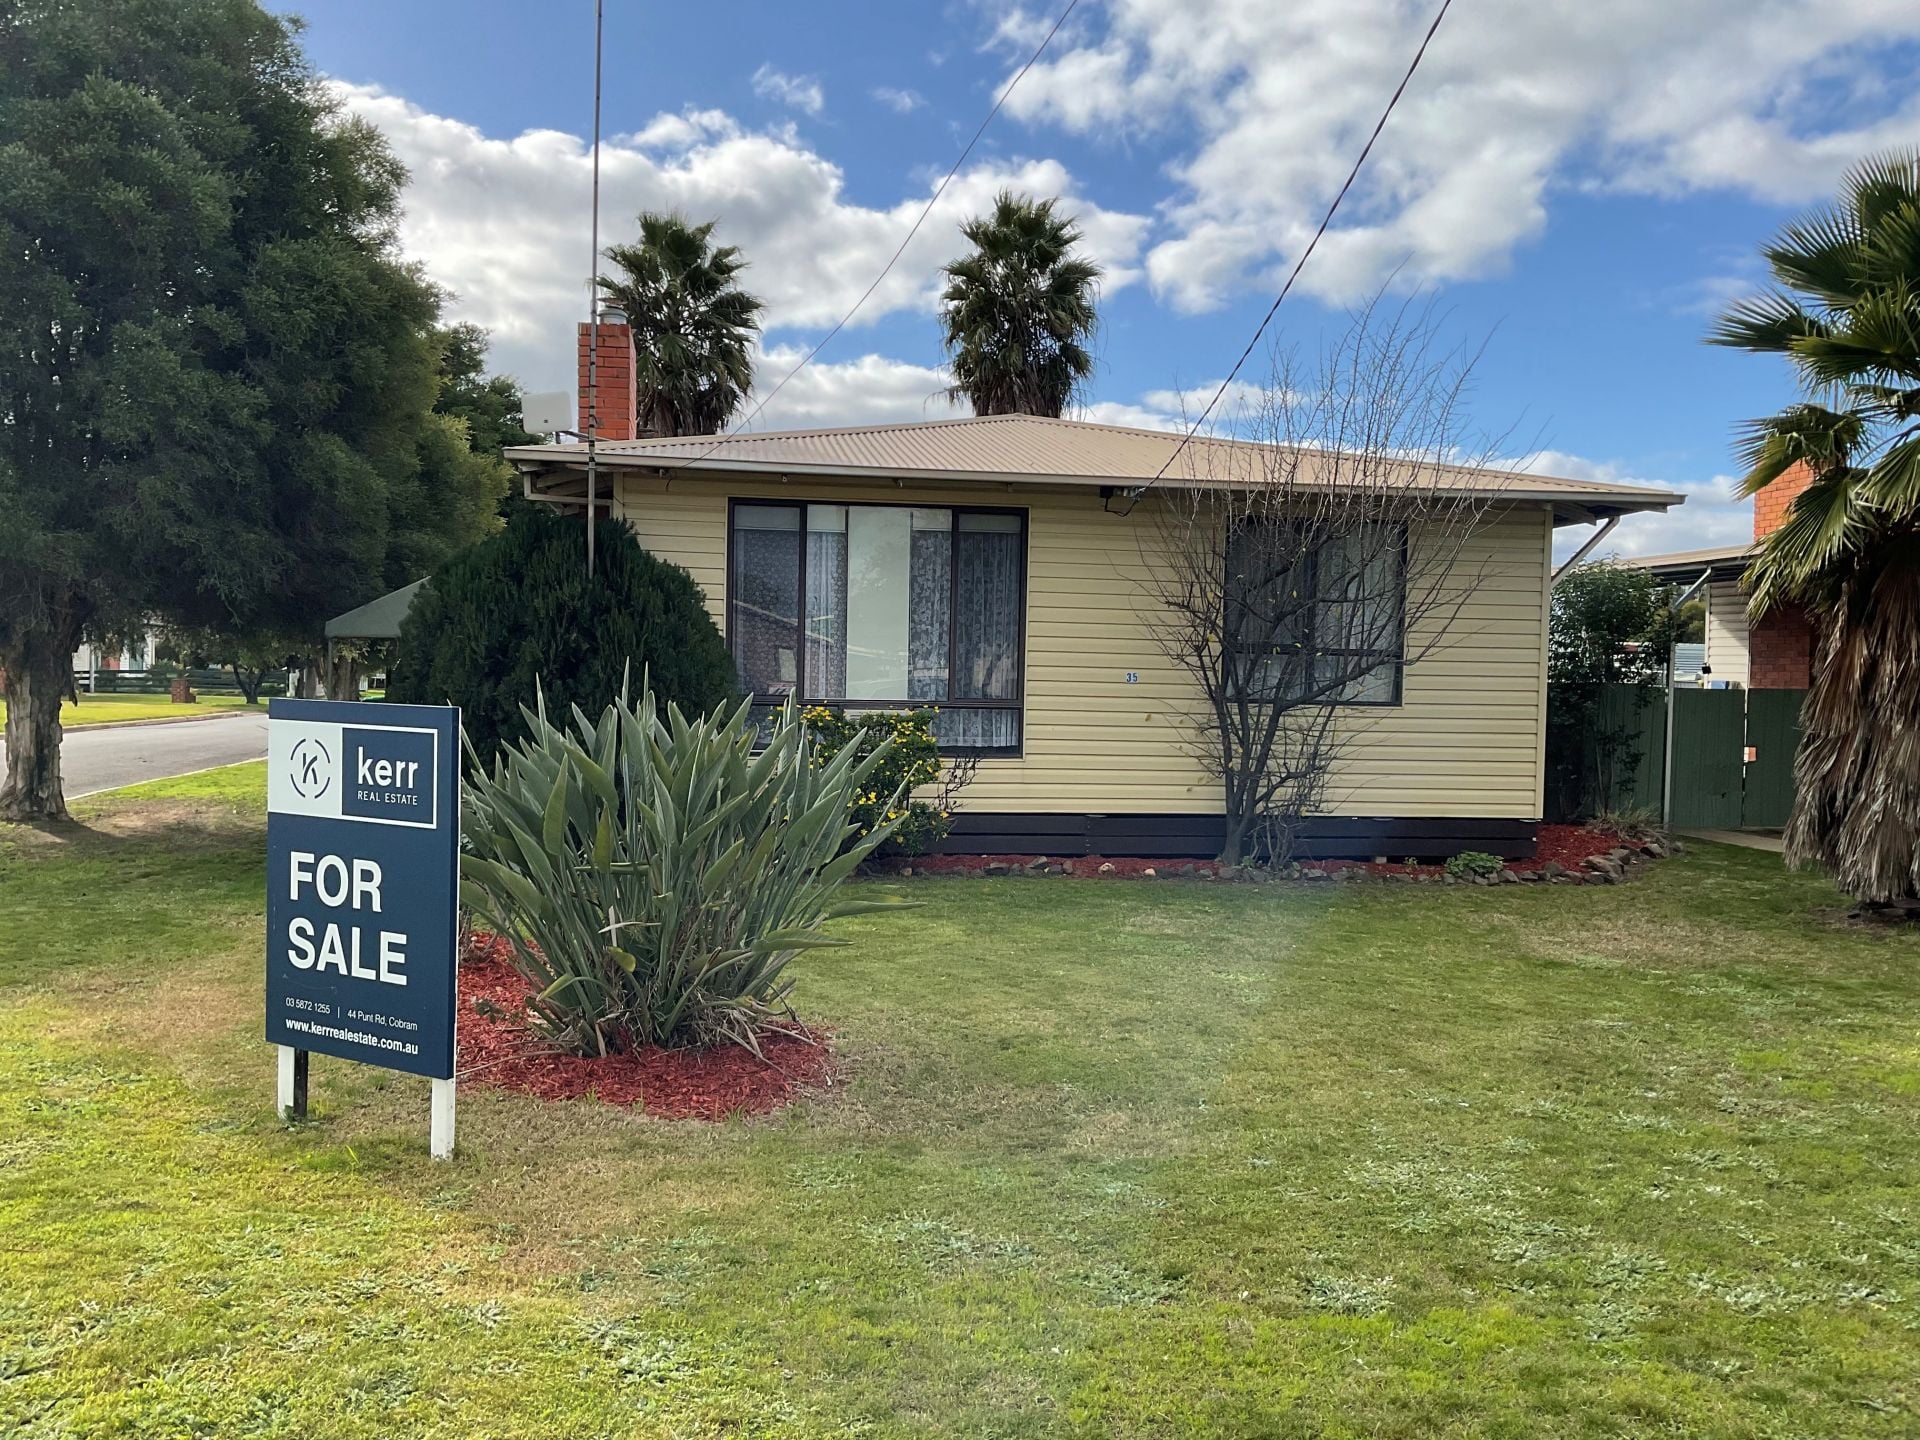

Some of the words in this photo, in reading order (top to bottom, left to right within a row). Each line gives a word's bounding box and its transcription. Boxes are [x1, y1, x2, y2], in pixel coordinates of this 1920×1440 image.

[1126, 672, 1138, 683] 35
[357, 746, 419, 789] kerr
[357, 790, 381, 803] REAL
[384, 793, 419, 806] ESTATE
[290, 851, 382, 912] FOR
[287, 917, 407, 986] SALE
[285, 997, 295, 1007] 03
[295, 999, 312, 1011] 5872
[314, 1003, 331, 1014] 1255
[347, 1009, 357, 1019] 44
[357, 1010, 374, 1023] Punt
[374, 1015, 387, 1026] Rd,
[388, 1017, 418, 1031] Cobram
[285, 1018, 419, 1054] www.kerrrealestate.com.au
